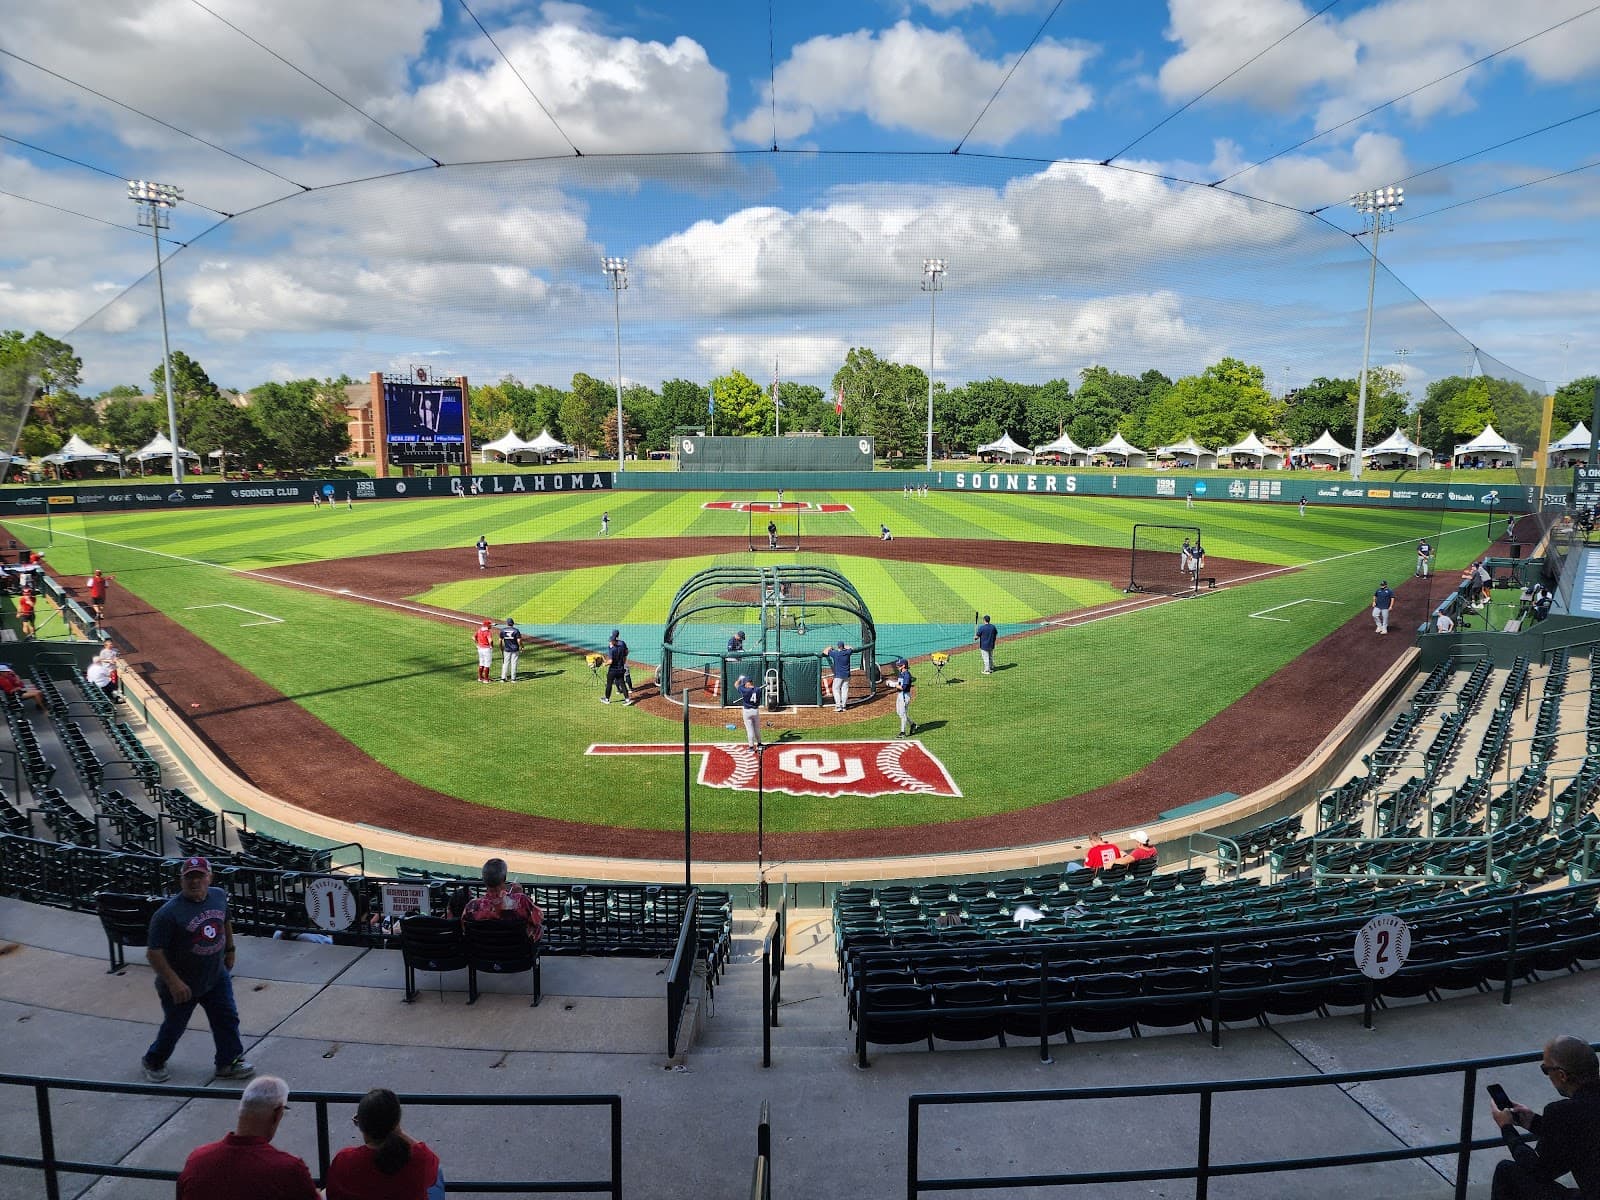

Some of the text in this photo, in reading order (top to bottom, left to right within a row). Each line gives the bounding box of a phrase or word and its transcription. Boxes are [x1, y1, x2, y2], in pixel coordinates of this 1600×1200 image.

[682, 439, 695, 454] OU
[859, 439, 871, 454] OU
[451, 474, 603, 494] OKLAHOMA
[956, 473, 1076, 492] SOONERS
[240, 488, 275, 498] SOONER
[276, 487, 299, 496] CLUB
[749, 692, 758, 704] 4
[779, 748, 865, 784] OU
[326, 890, 335, 918] 1
[204, 925, 216, 938] OU
[1376, 930, 1390, 964] 2
